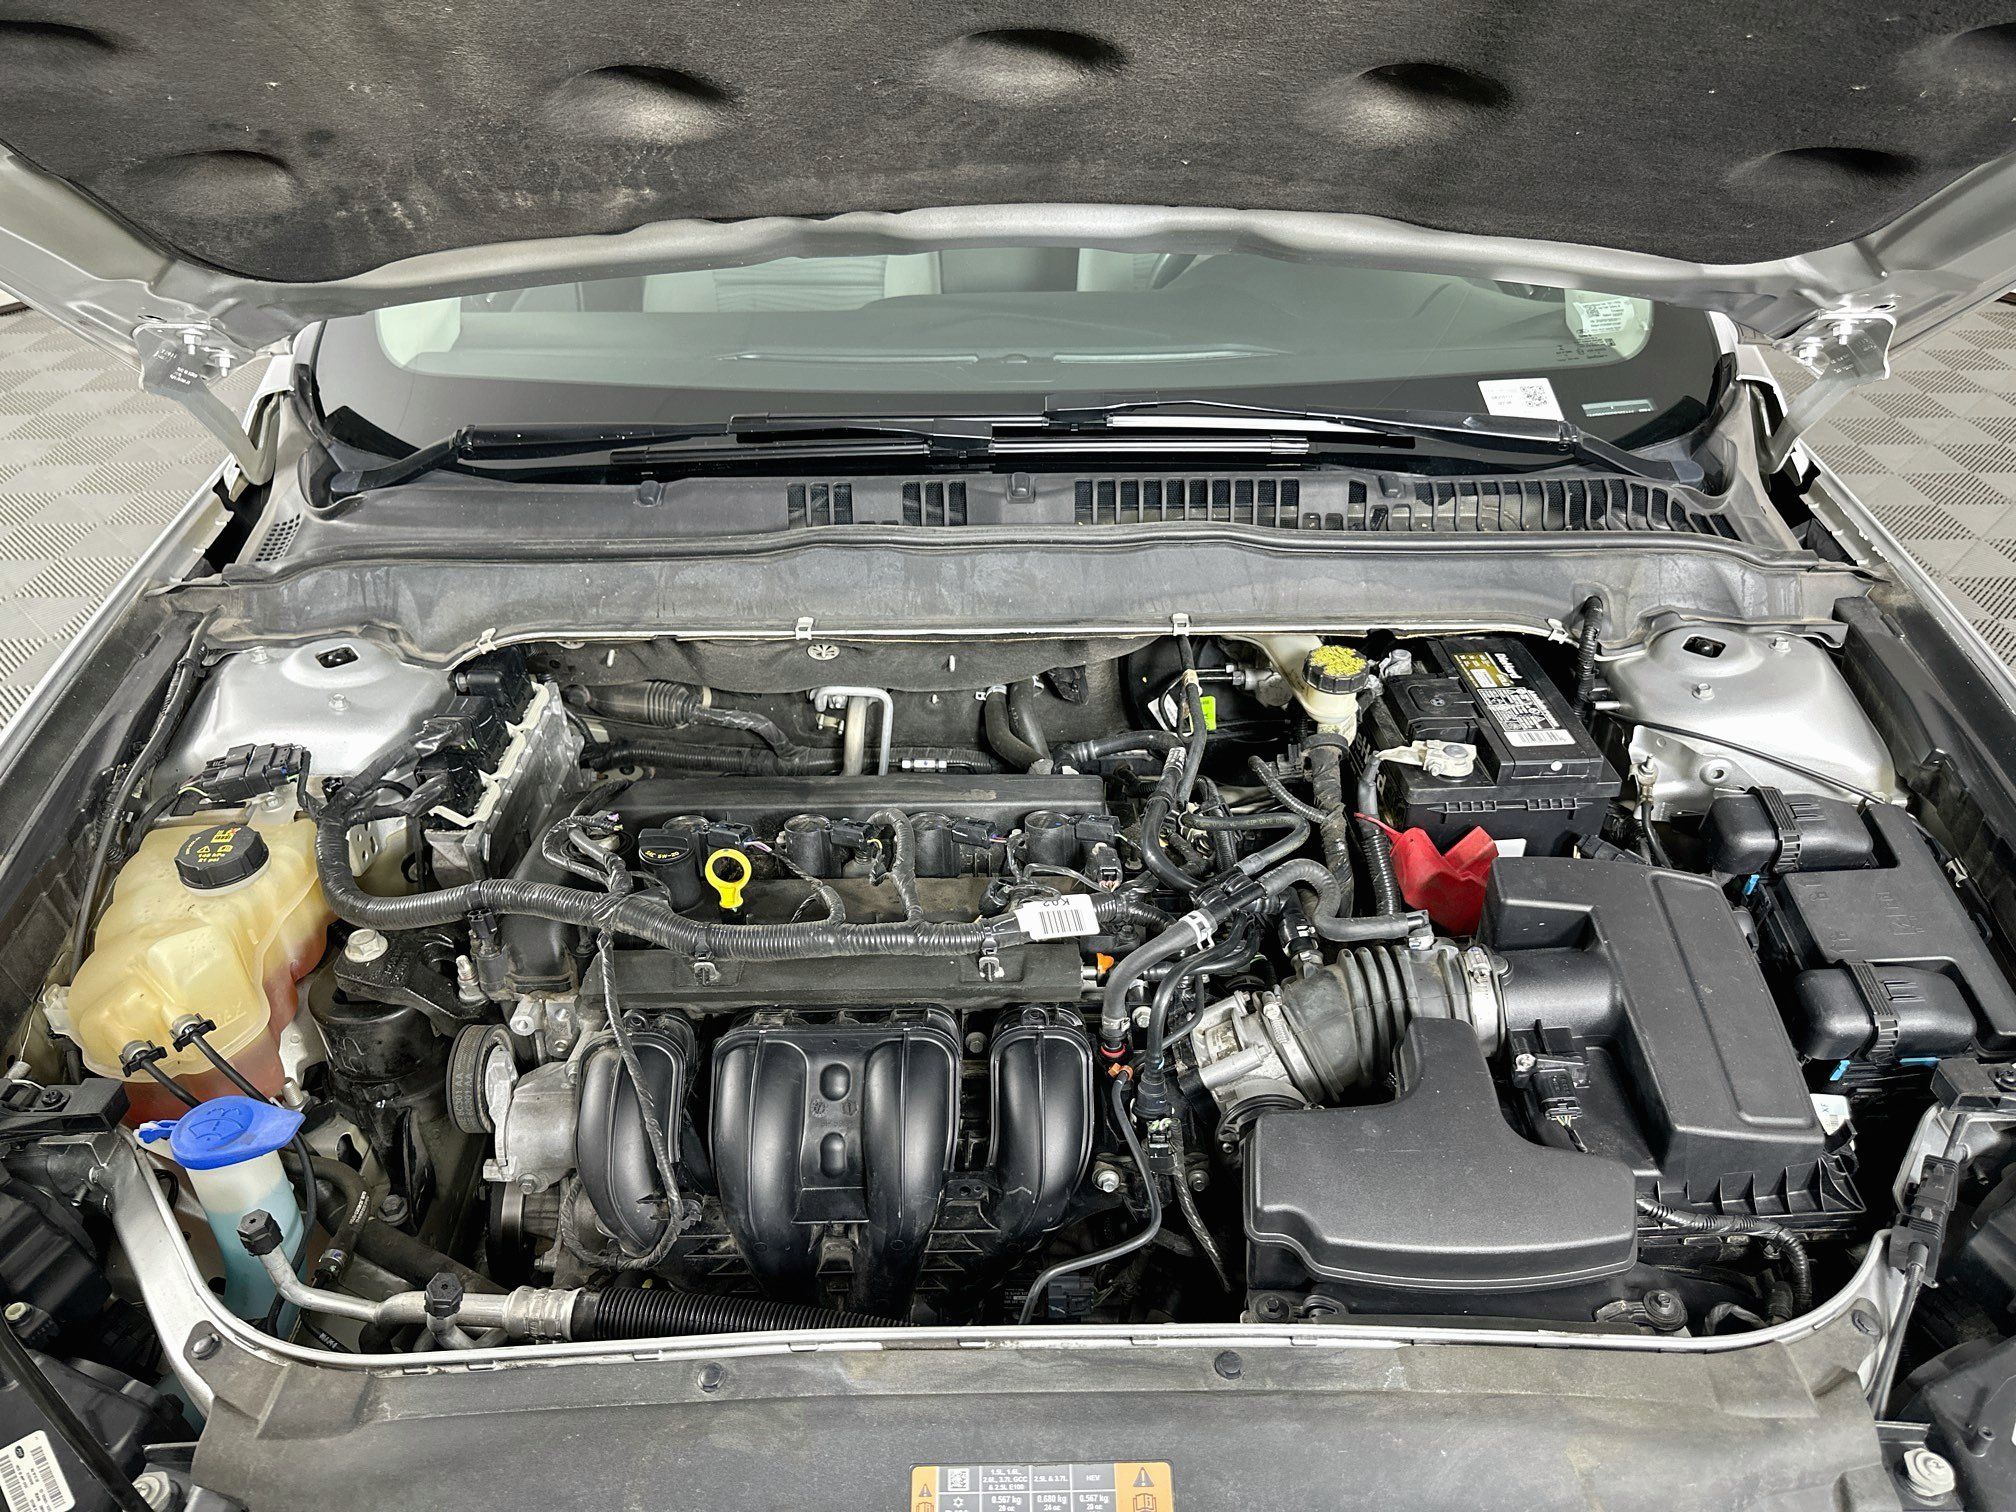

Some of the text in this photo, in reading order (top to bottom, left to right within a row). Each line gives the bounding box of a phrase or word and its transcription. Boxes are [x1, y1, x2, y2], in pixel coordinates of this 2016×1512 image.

[1012, 1496, 1022, 1505] kg
[1057, 1494, 1067, 1504] kg
[1099, 1494, 1109, 1503] kg
